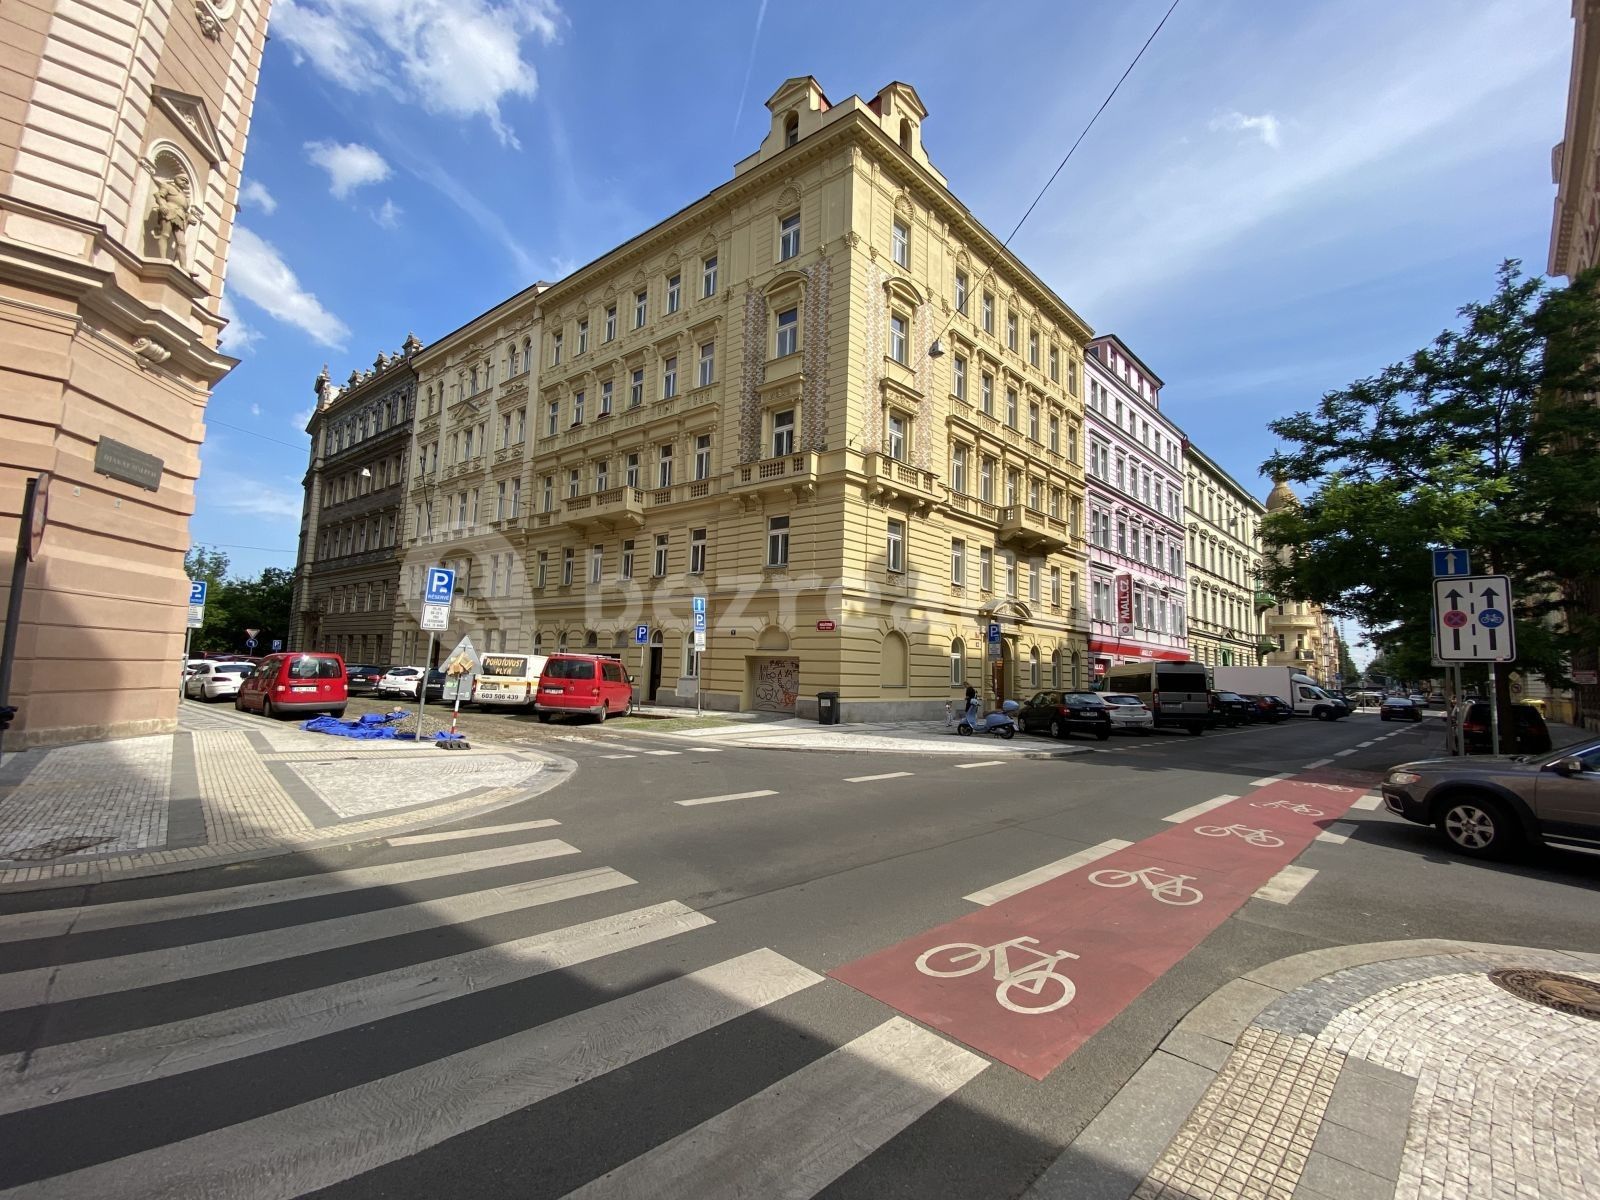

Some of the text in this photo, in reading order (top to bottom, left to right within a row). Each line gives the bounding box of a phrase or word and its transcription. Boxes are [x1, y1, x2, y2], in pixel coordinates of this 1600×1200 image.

[432, 572, 448, 592] P
[1120, 578, 1130, 619] MALL.CZ
[639, 627, 646, 638] P
[485, 657, 525, 667] POHOTOVOST
[495, 667, 513, 675] PLYN
